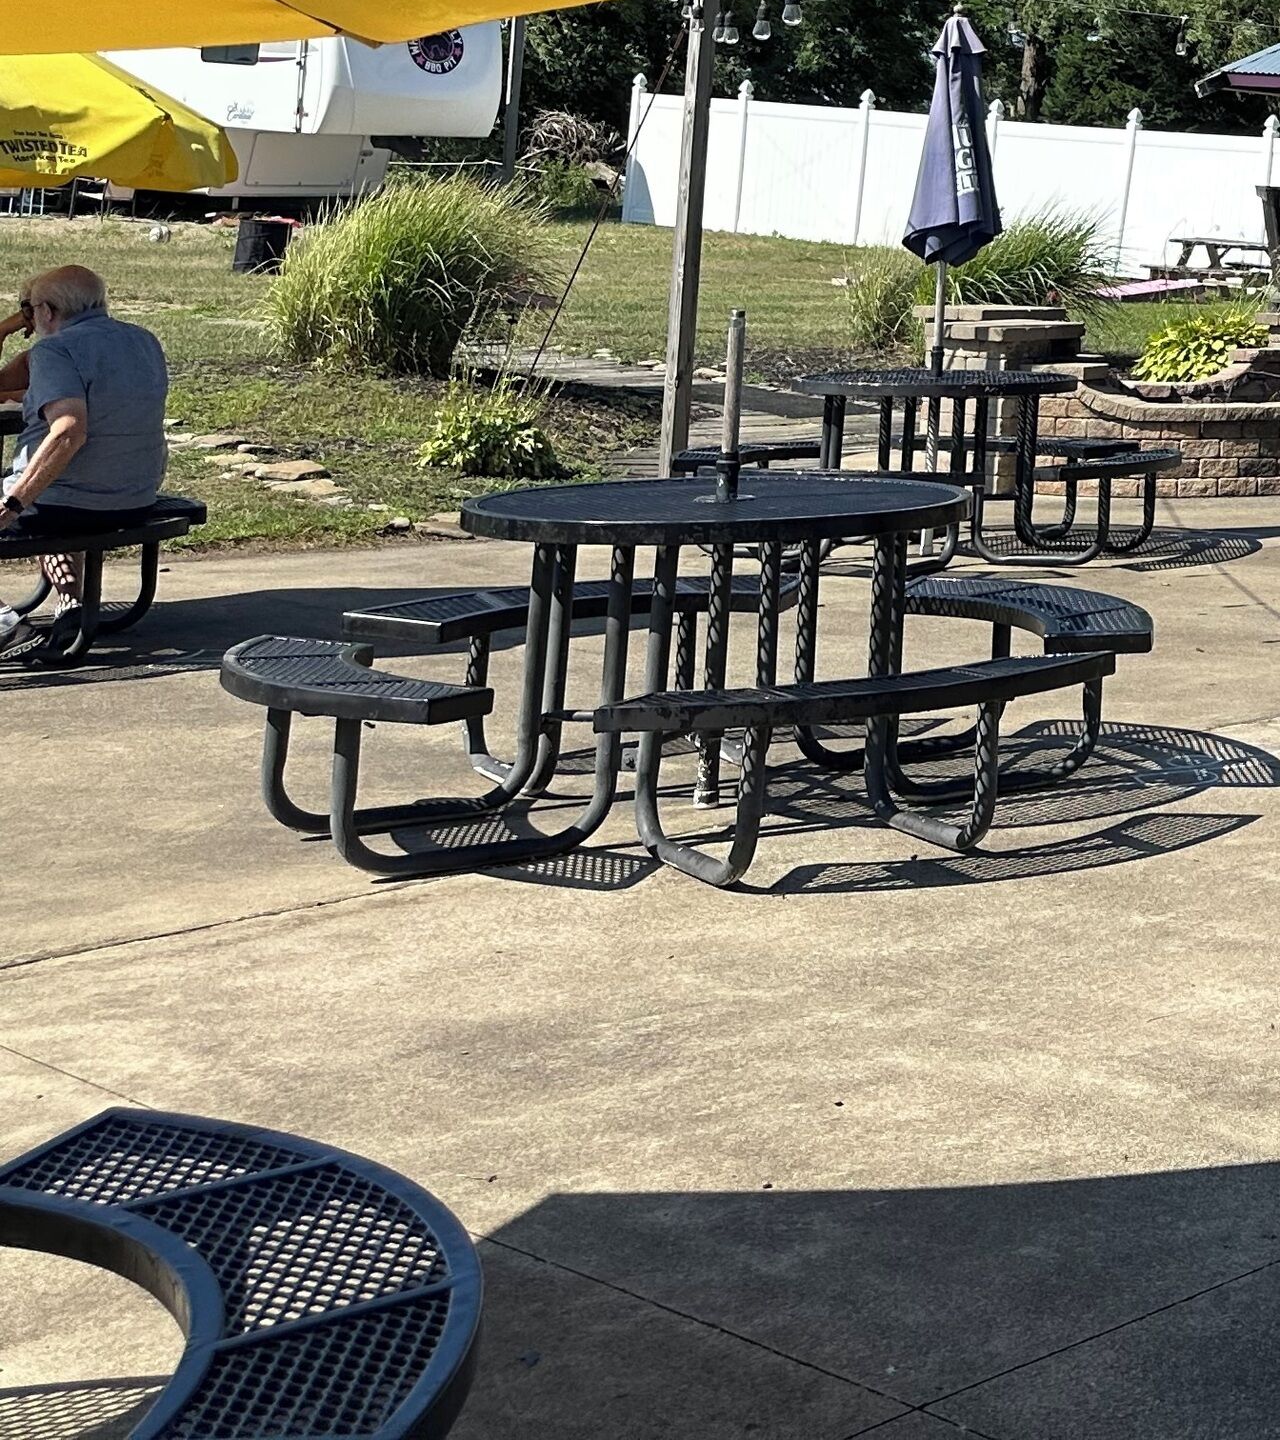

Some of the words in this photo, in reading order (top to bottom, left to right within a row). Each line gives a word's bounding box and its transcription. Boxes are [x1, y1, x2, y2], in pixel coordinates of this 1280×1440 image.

[424, 61, 442, 73] BBQ
[444, 56, 457, 71] PIT
[0, 139, 58, 155] TWISTED
[59, 141, 87, 157] TEA
